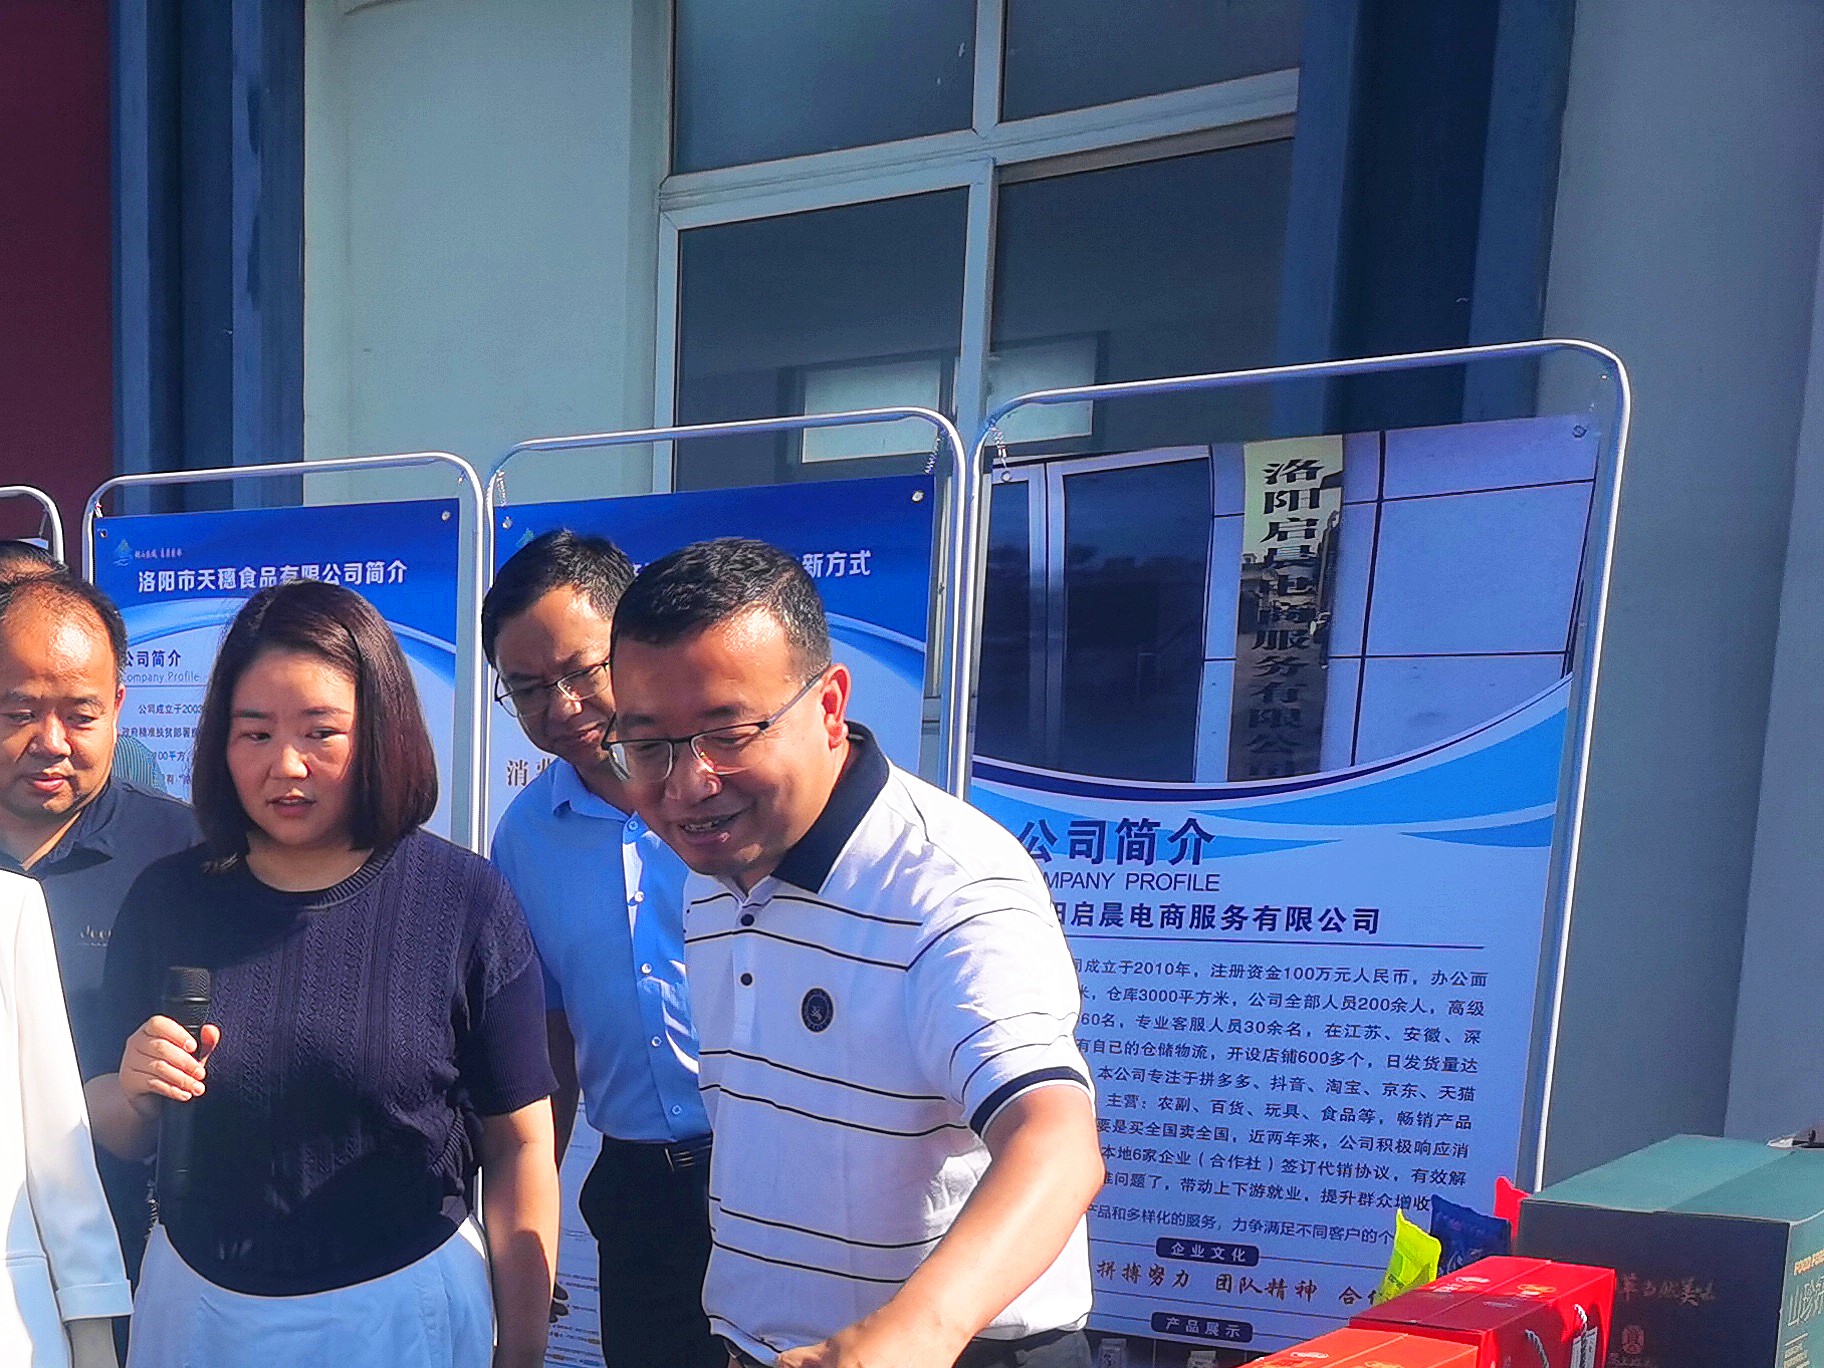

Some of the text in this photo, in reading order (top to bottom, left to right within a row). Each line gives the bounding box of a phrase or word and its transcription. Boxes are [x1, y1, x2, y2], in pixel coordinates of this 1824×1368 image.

[125, 671, 200, 684] ompany Profile
[1019, 817, 1216, 866] 公司简介
[1044, 872, 1221, 892] MPANY PROFILE
[1170, 1242, 1247, 1263] 企业文化
[1096, 1260, 1190, 1288] 拼搏努力
[1215, 1273, 1318, 1303] 团队精神
[1165, 1316, 1242, 1339] 产品展示
